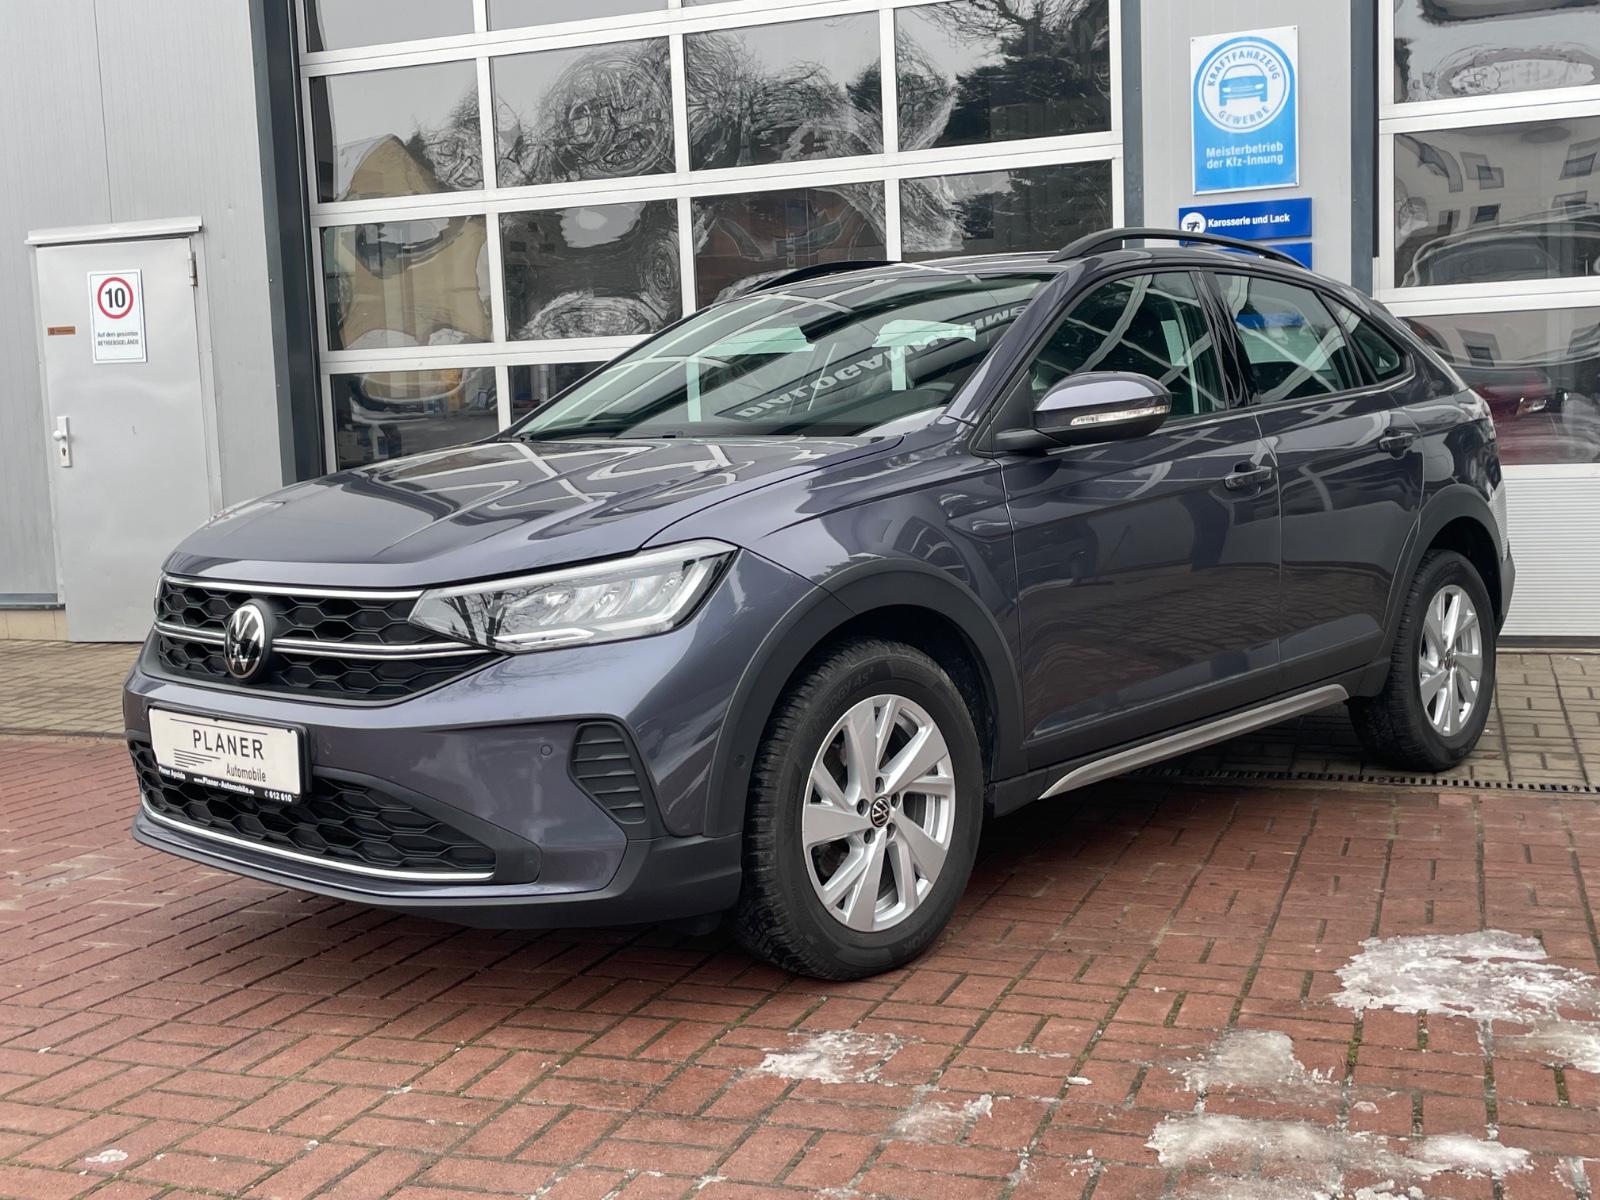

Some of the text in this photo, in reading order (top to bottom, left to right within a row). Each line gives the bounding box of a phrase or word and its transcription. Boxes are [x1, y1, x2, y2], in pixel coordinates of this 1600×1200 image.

[1208, 50, 1281, 87] KRAFTFAHRZEUG
[1218, 105, 1271, 124] GEWERBE
[1206, 141, 1284, 158] Meisterbetrieb
[1206, 153, 1284, 169] der Kfz-Innung
[1208, 213, 1290, 228] Karosserie und Lack
[105, 287, 126, 308] 10
[192, 729, 265, 760] PLANER
[225, 763, 266, 782] Automobile
